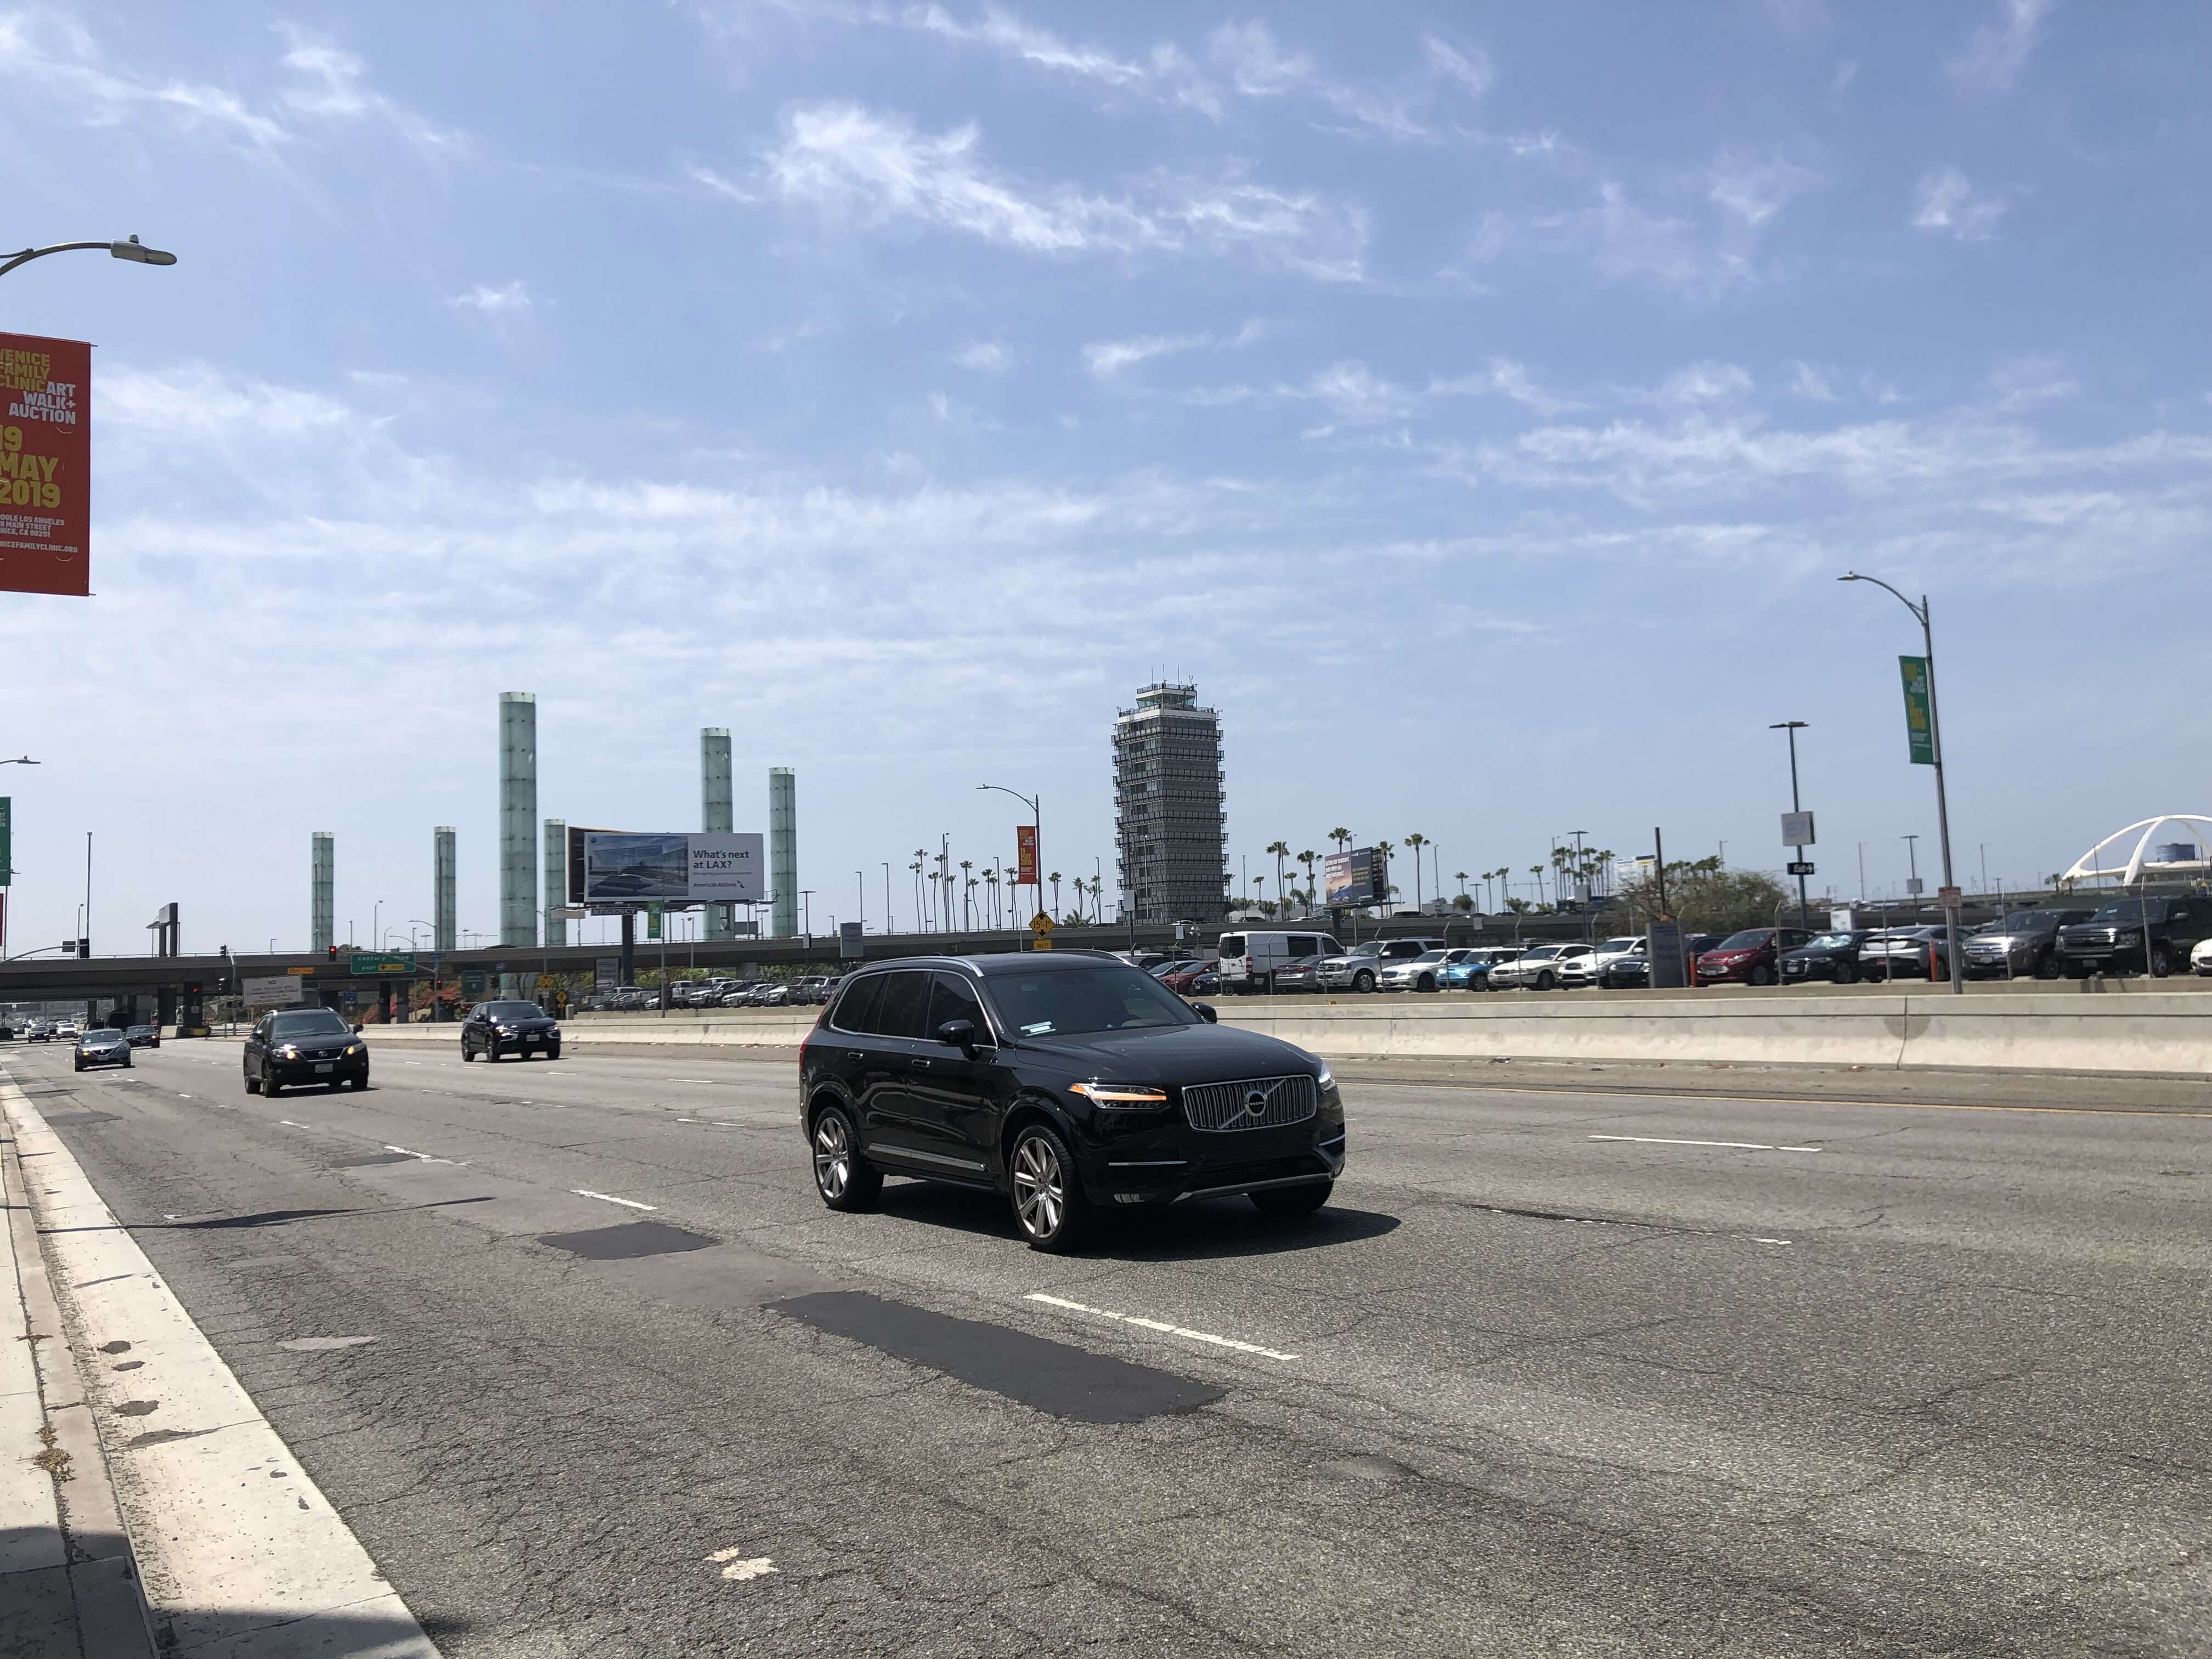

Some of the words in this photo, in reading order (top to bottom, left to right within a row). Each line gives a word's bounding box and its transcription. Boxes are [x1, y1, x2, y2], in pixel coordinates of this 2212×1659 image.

[46, 381, 76, 397] ART
[22, 391, 76, 410] WALK+
[8, 402, 76, 425] AUCTION
[0, 450, 59, 482] MAY
[0, 477, 60, 509] 2019
[25, 523, 52, 531] STREET
[34, 517, 65, 526] ANGELES
[693, 850, 727, 859] What's
[728, 850, 750, 859] next
[706, 860, 732, 868] LAX?
